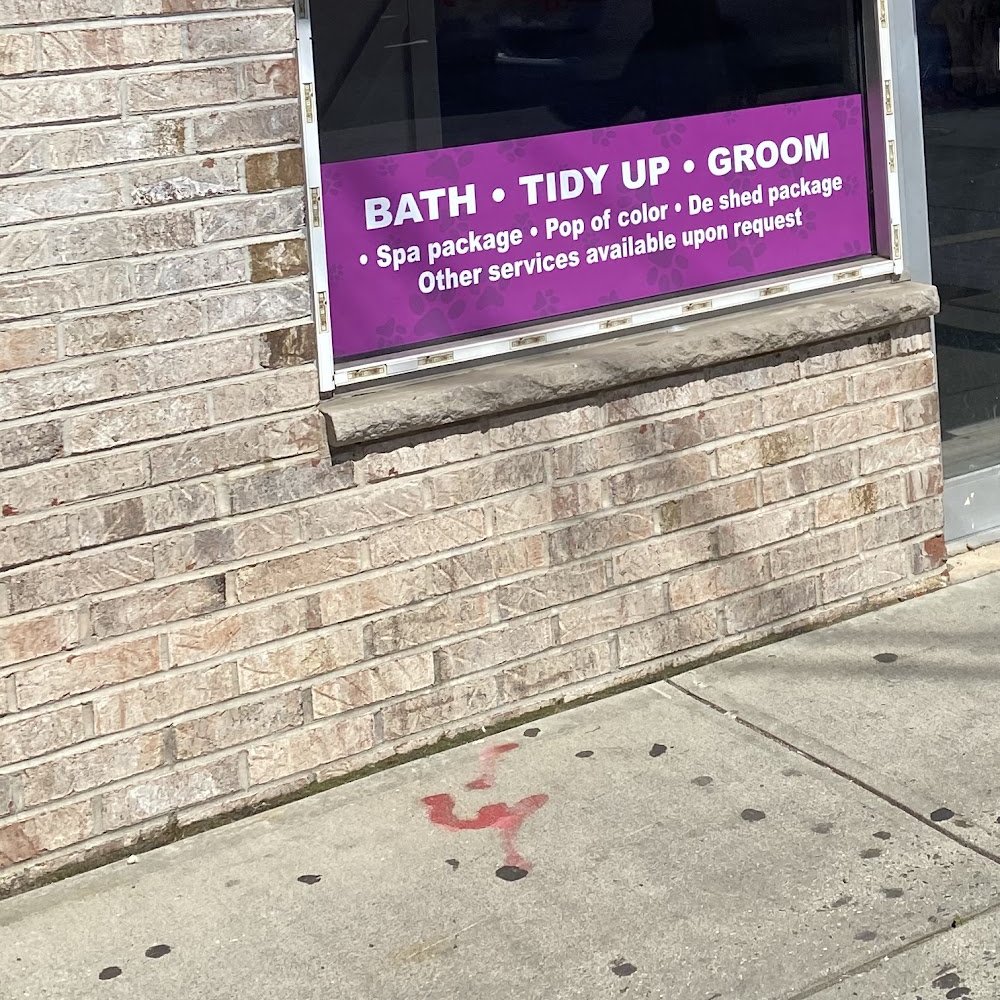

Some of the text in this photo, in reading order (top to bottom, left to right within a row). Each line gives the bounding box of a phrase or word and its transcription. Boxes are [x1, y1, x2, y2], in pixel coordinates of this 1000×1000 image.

[364, 131, 831, 231] BATH TIDY UP GROOM
[376, 173, 843, 272] Spa package Pop of color De shed package
[418, 207, 803, 295] Other services available upon request
